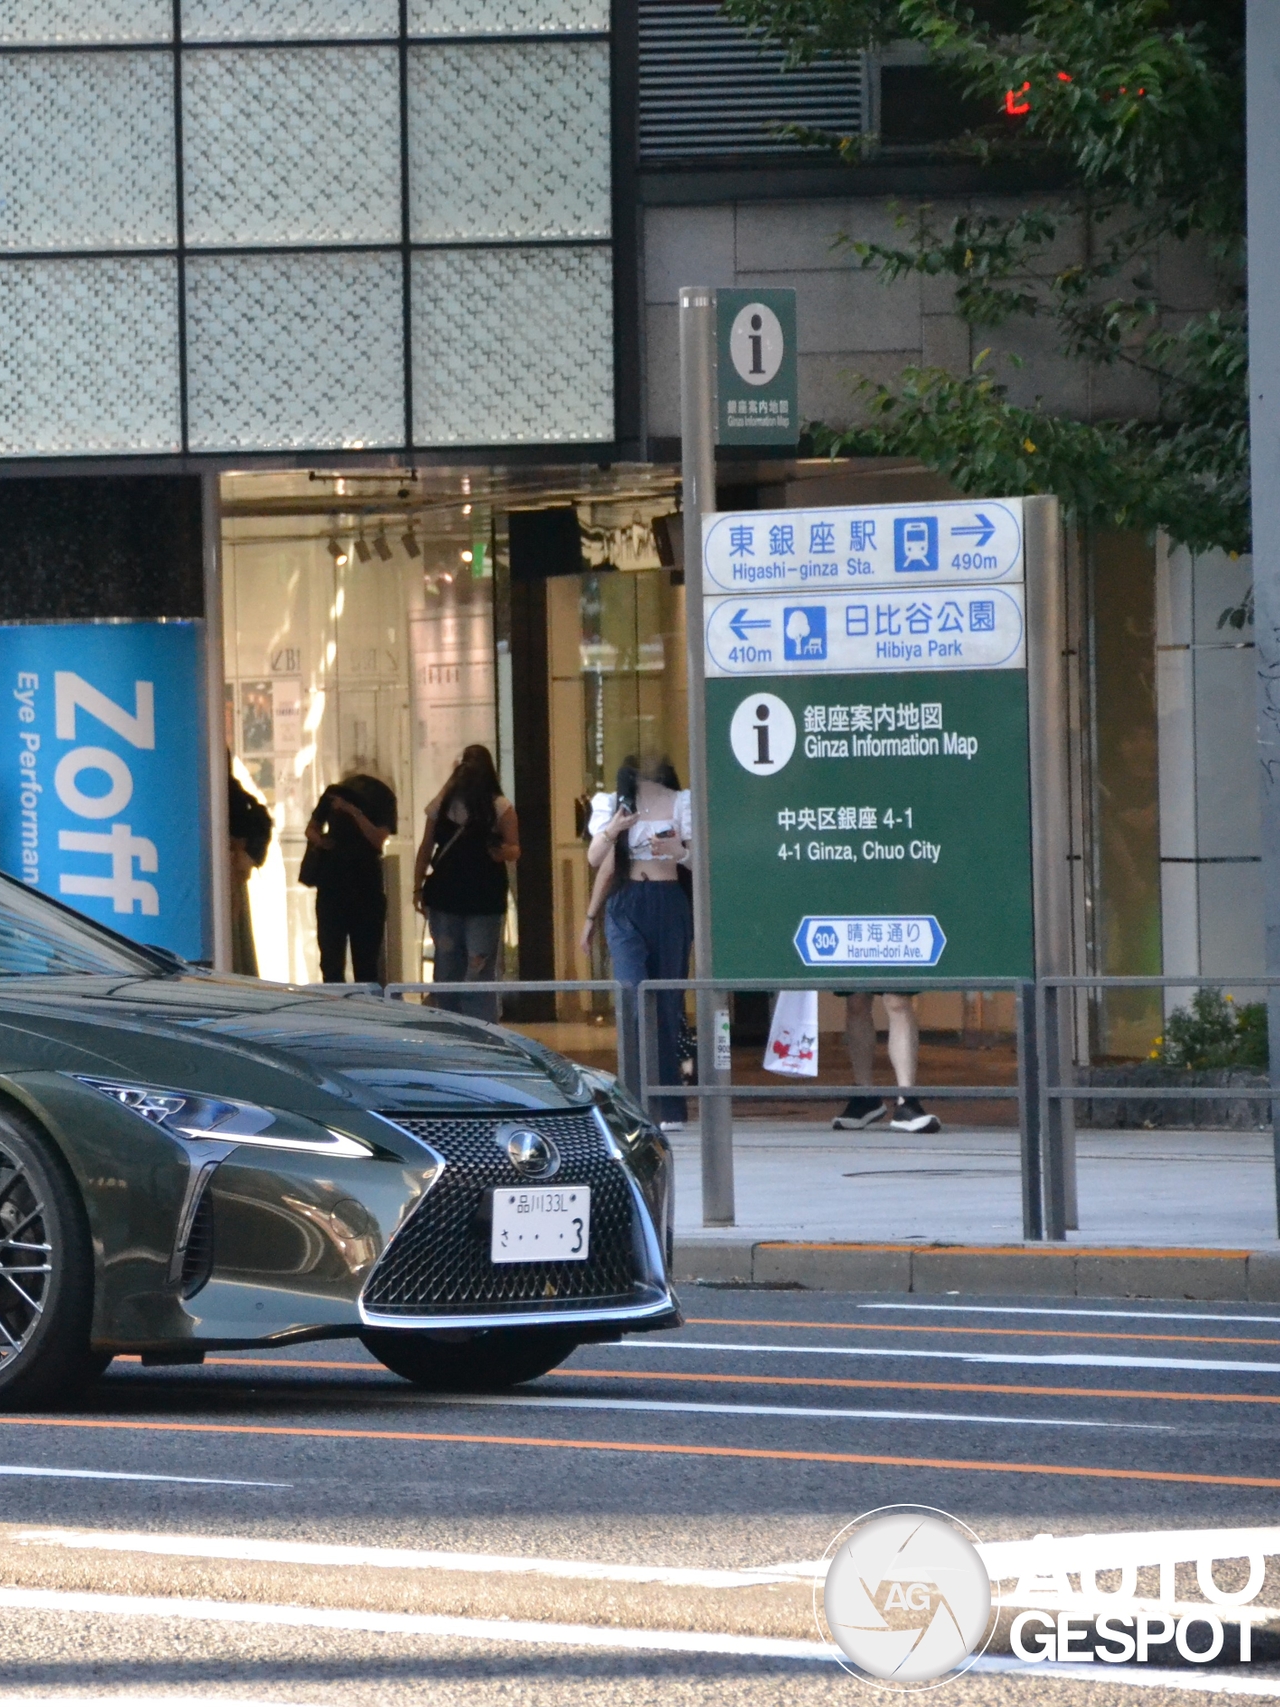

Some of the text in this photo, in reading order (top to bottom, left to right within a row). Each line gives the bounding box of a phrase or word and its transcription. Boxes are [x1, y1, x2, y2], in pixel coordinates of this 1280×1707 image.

[729, 520, 877, 558] 東銀座駅
[733, 558, 875, 583] Higashi-ginza Sta.
[951, 553, 997, 571] 490m
[846, 600, 995, 636] 日比谷公園
[728, 646, 772, 663] 410m
[876, 639, 963, 661] Hibiya Park
[14, 671, 39, 723] Eye
[804, 703, 943, 733] 銀座案内地図
[805, 732, 978, 760] Ginza Information Map
[55, 671, 160, 916] Zoff
[778, 807, 914, 831] 中央区銀座 4-1
[778, 840, 940, 862] 4-1 Ginza, Chuo City
[815, 933, 836, 949] 304
[847, 923, 920, 943] 晴海通り
[847, 944, 923, 958] Harumi-dori Ave.
